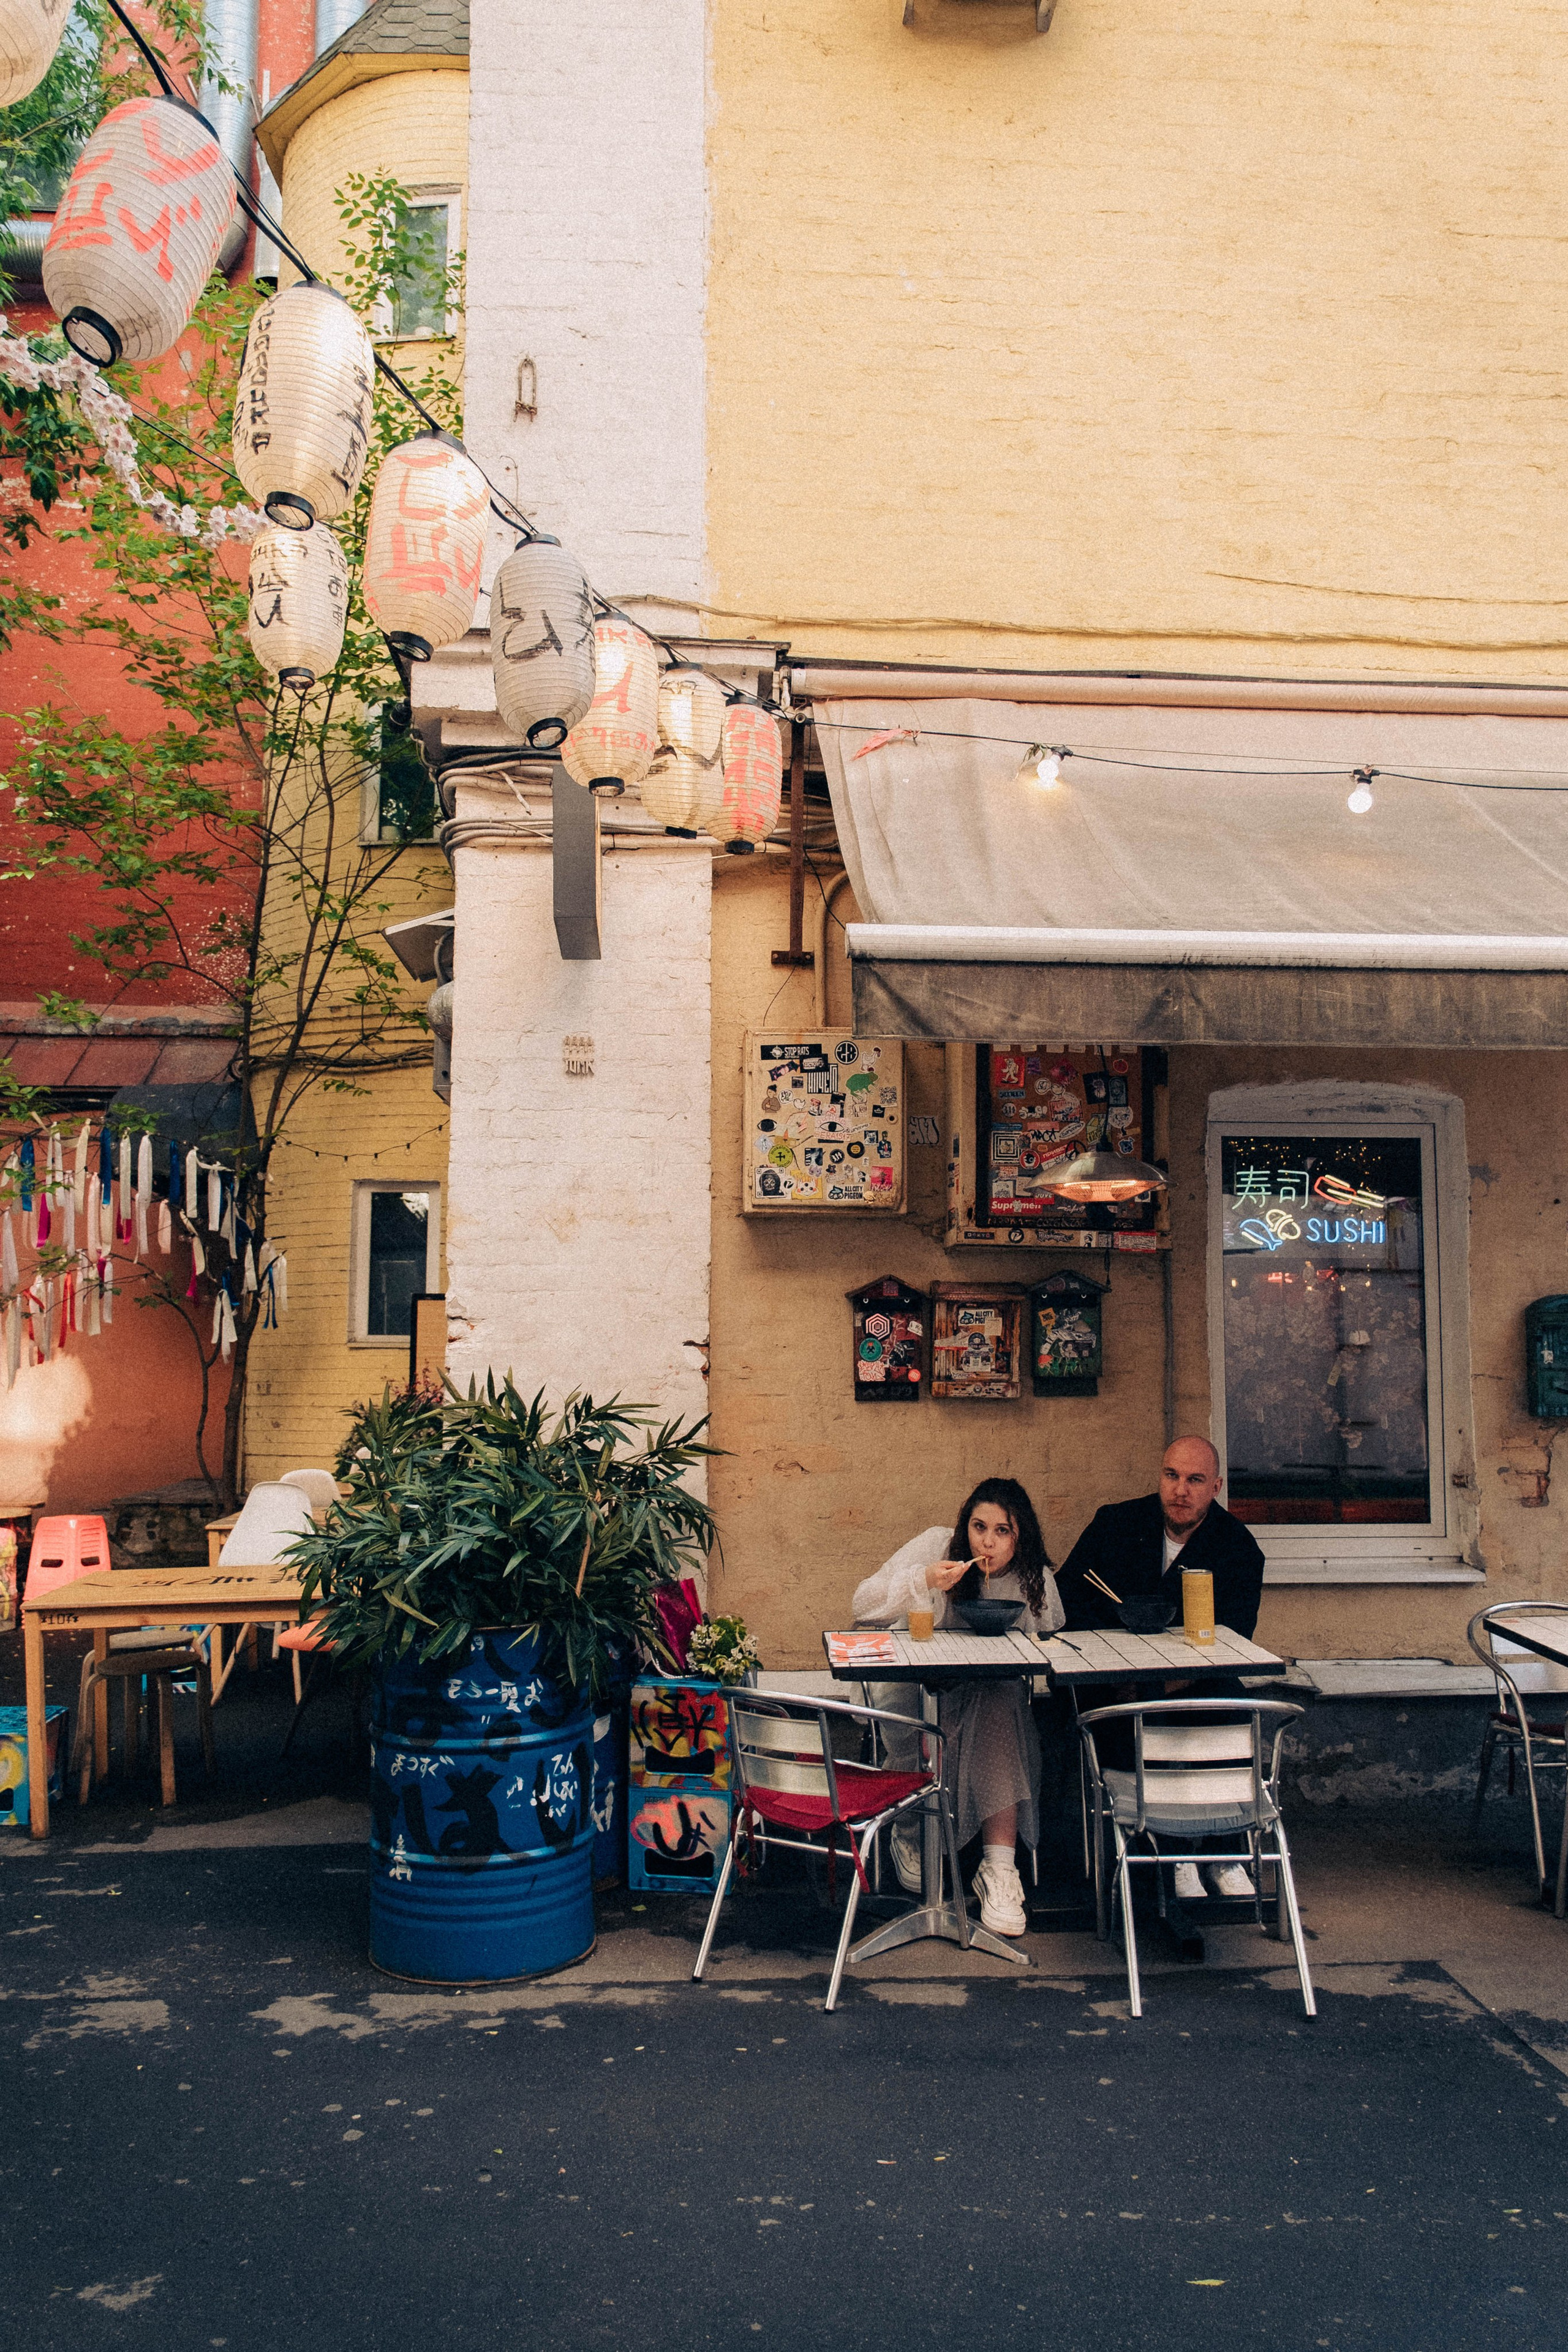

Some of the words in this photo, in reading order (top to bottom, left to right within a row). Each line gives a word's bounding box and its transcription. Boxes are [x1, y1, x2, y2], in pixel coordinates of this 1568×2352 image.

[785, 1047, 796, 1056] STOP
[797, 1046, 809, 1055] RATS
[1232, 1165, 1310, 1209] 寿司
[1306, 1218, 1384, 1243] SUSHI
